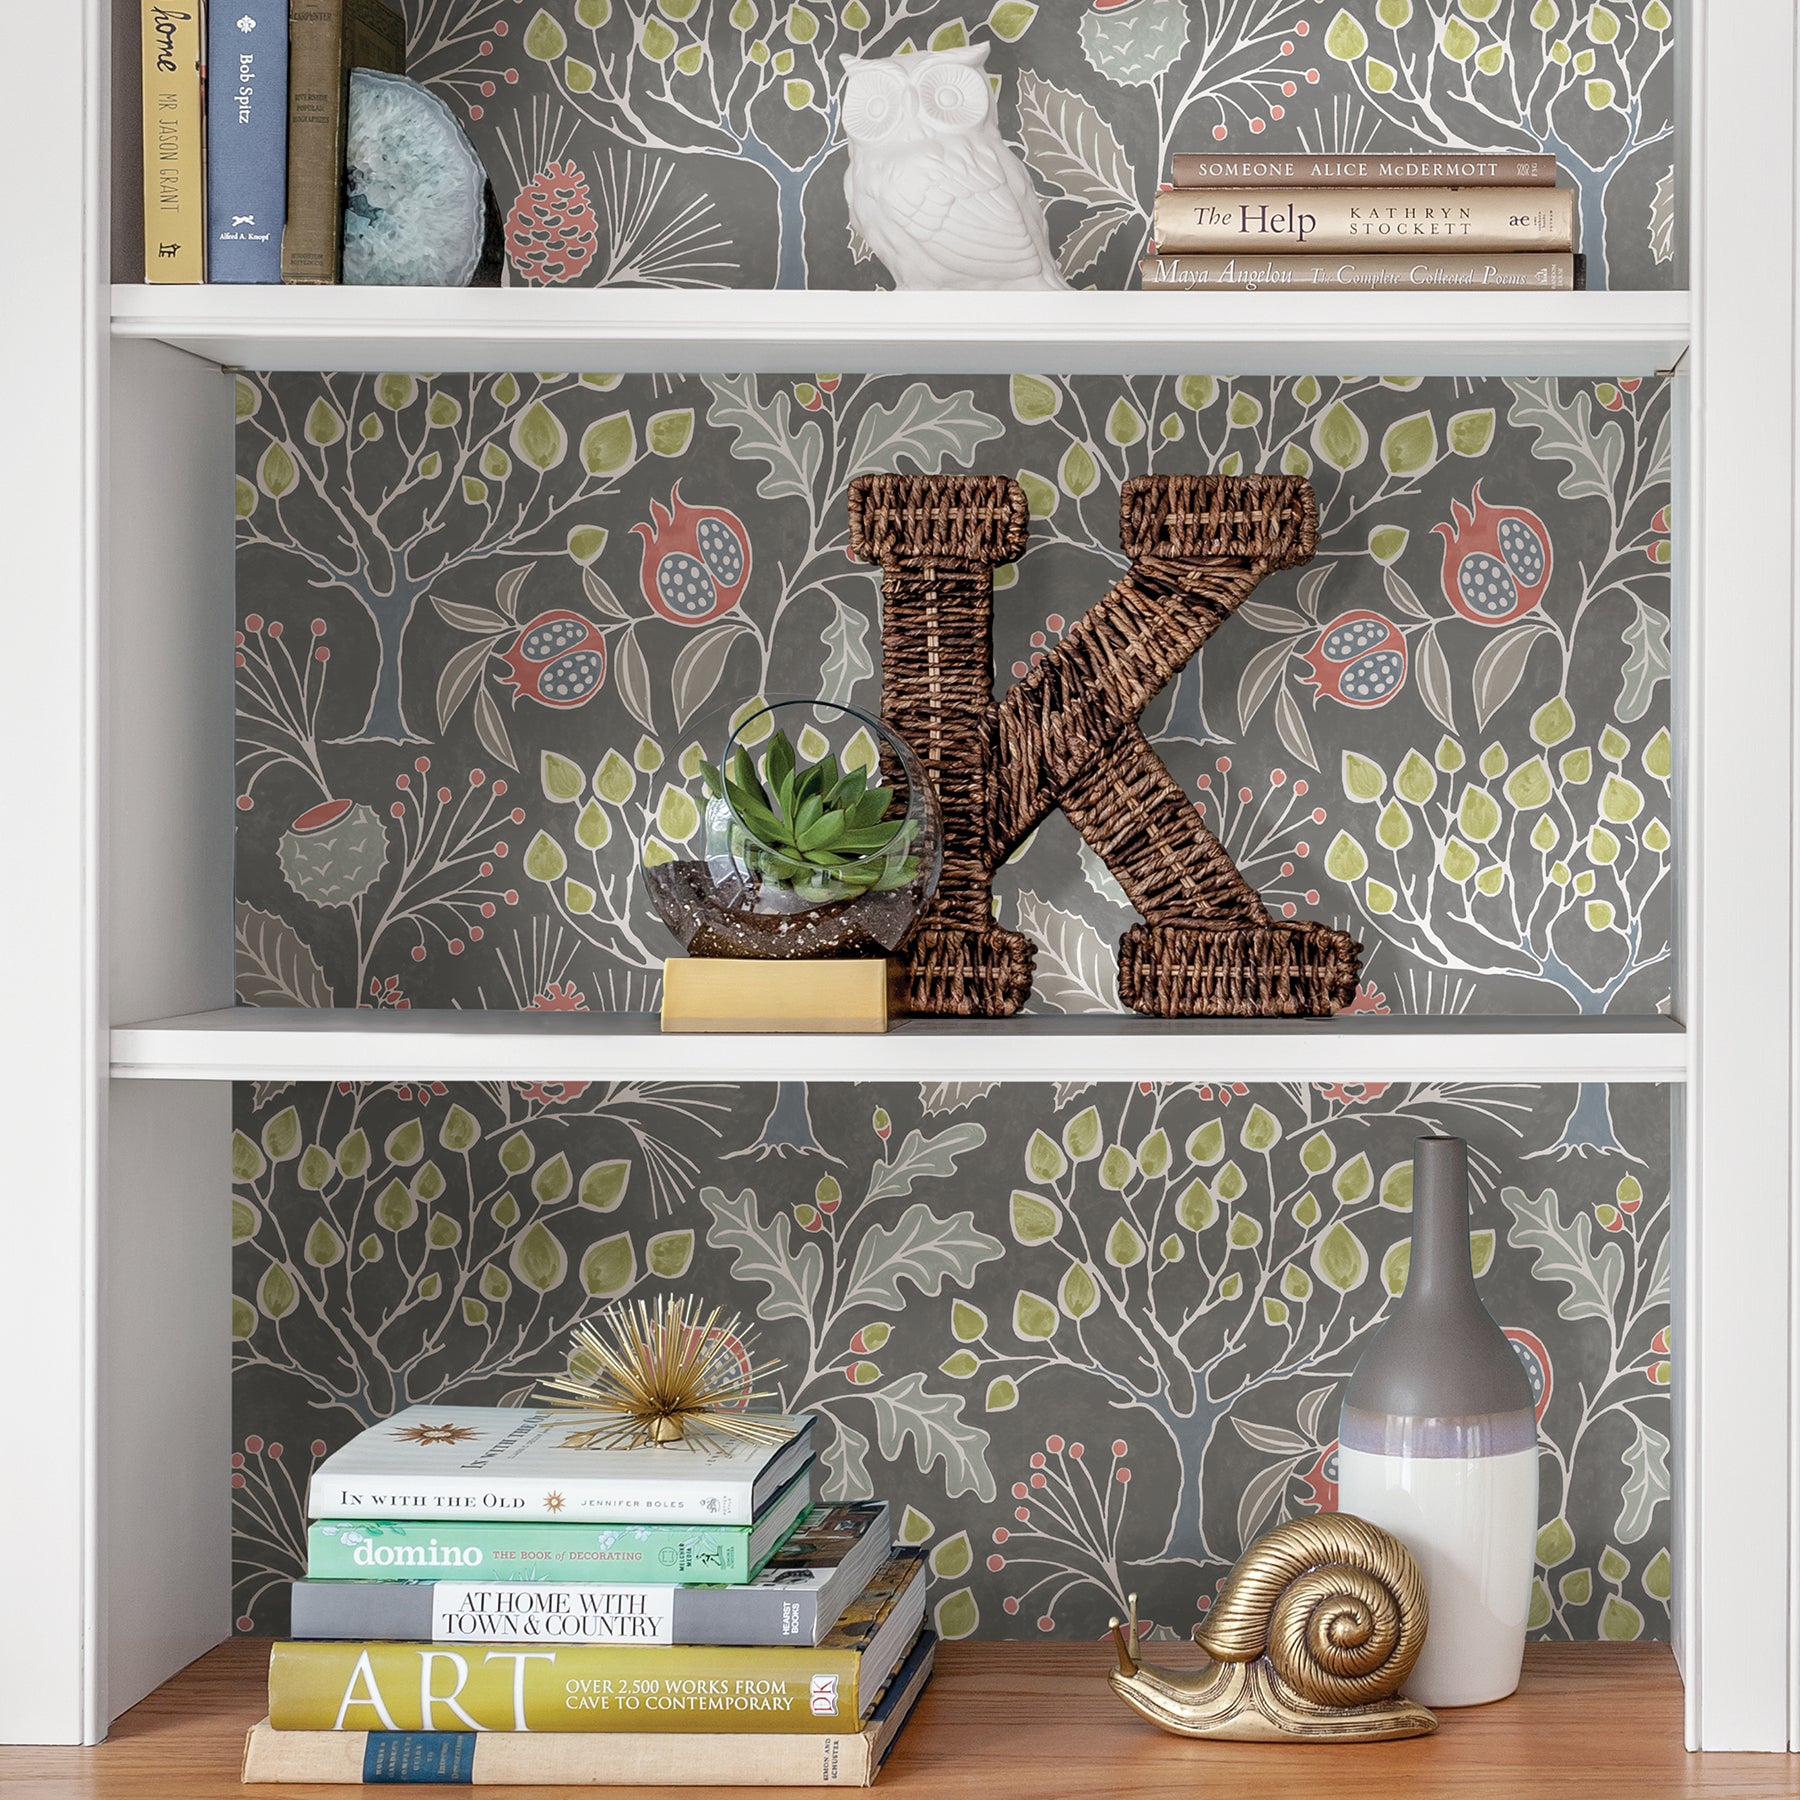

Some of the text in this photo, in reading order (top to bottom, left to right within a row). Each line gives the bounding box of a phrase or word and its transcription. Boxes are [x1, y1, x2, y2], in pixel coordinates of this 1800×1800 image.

[151, 6, 192, 73] home
[234, 53, 255, 124] Bob Spitz
[158, 93, 180, 213] MR JASON GRANT
[1199, 163, 1498, 177] SOMEONE ALICE McDERMOTT
[1193, 204, 1317, 242] The Help
[1349, 207, 1471, 219] KATHRYN
[219, 232, 238, 240] Alfred
[248, 232, 270, 243] Knopf
[1349, 223, 1472, 235] STOCKETT
[1154, 259, 1527, 291] Maya Angelou The Complete Collected Poems
[354, 1538, 483, 1566] domino
[492, 1551, 642, 1561] THE BOOK of DECORATING
[458, 1592, 647, 1615] AT HOME WITH
[442, 1613, 664, 1637] TOWN & COUNTRY
[782, 1601, 791, 1635] HEARST
[791, 1603, 800, 1633] BOOKS
[333, 1649, 557, 1731] ART
[565, 1679, 787, 1696] OVER 2,500 WORKS FROM
[813, 1679, 834, 1712] DK
[565, 1695, 794, 1711] CAVE TO CONTEMPORARY
